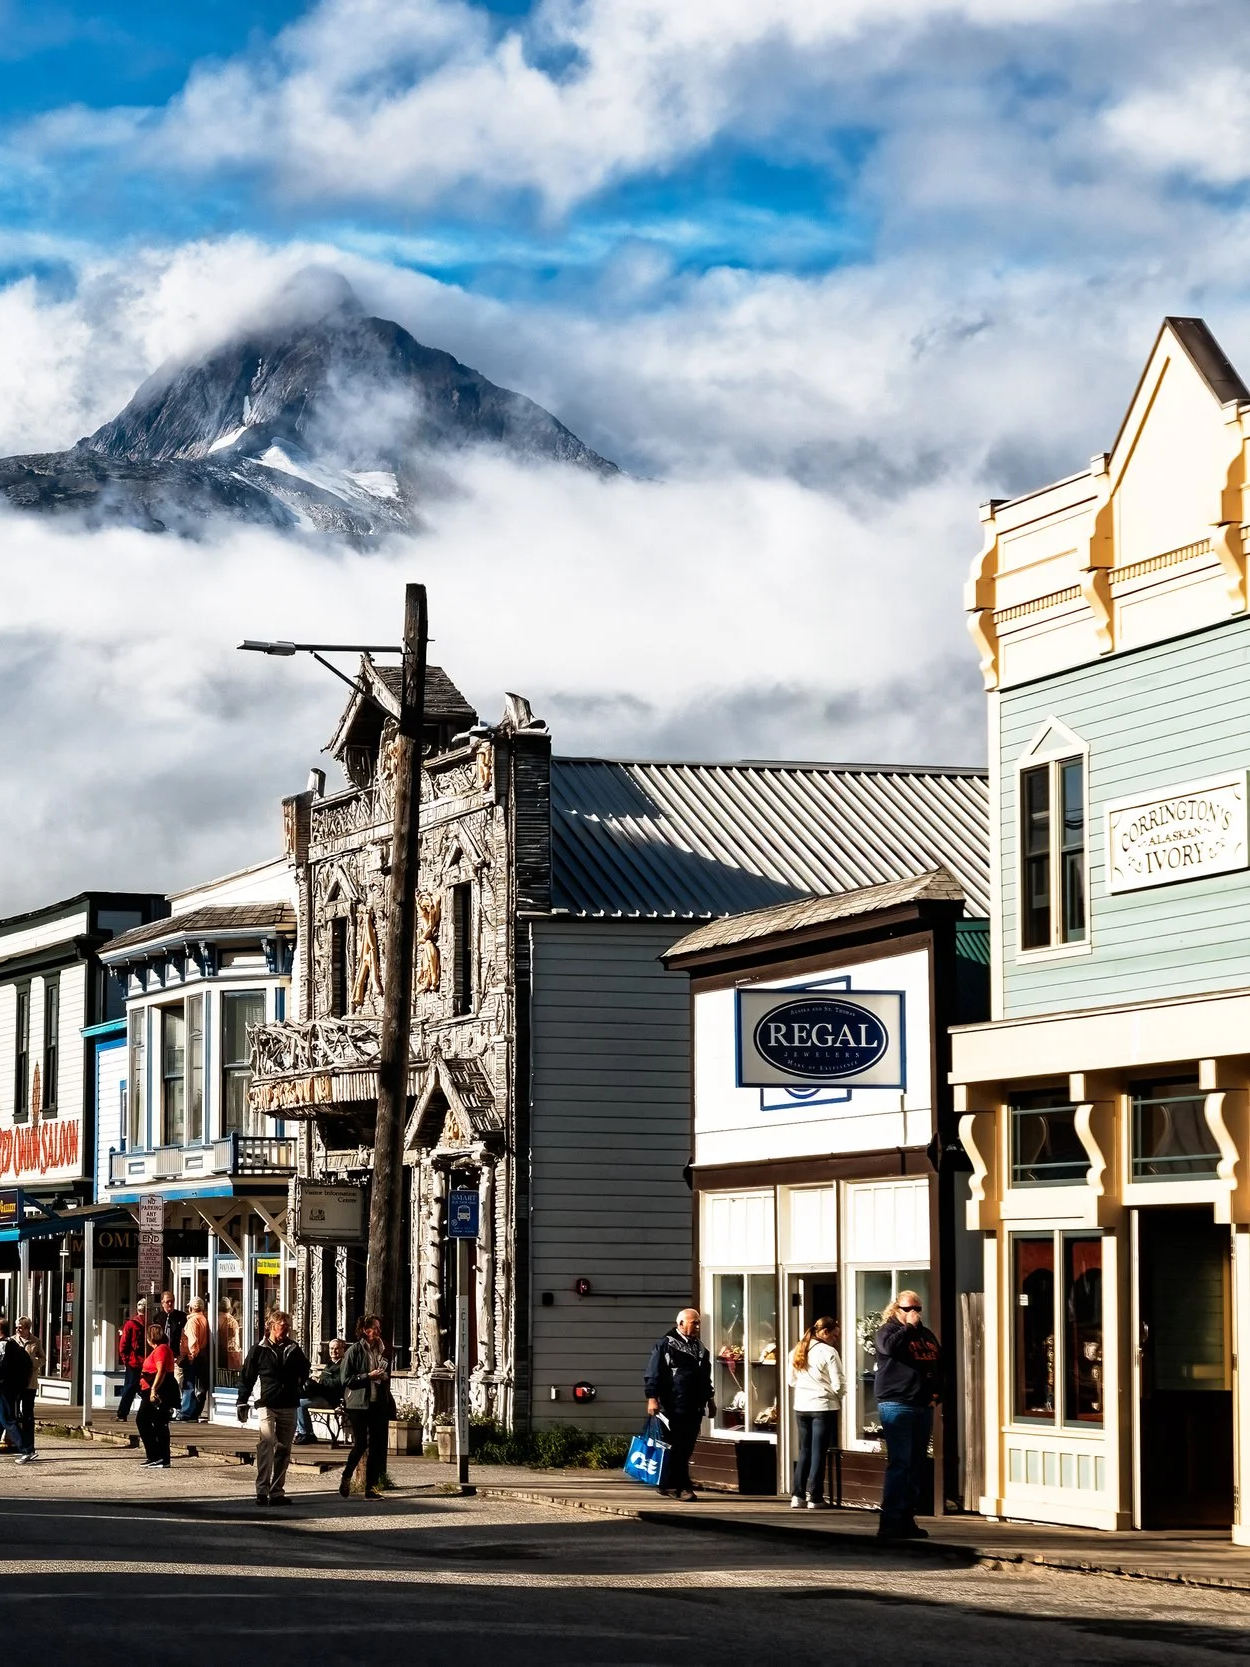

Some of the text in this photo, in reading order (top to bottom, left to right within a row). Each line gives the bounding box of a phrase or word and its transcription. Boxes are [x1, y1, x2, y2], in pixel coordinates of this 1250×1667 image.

[1121, 799, 1232, 852] CORRINGTON'S
[1150, 825, 1201, 846] ALASKAN
[1145, 841, 1204, 874] IVORY
[767, 1022, 878, 1048] REGAL
[40, 1118, 79, 1176] SALOON
[142, 1235, 160, 1243] END
